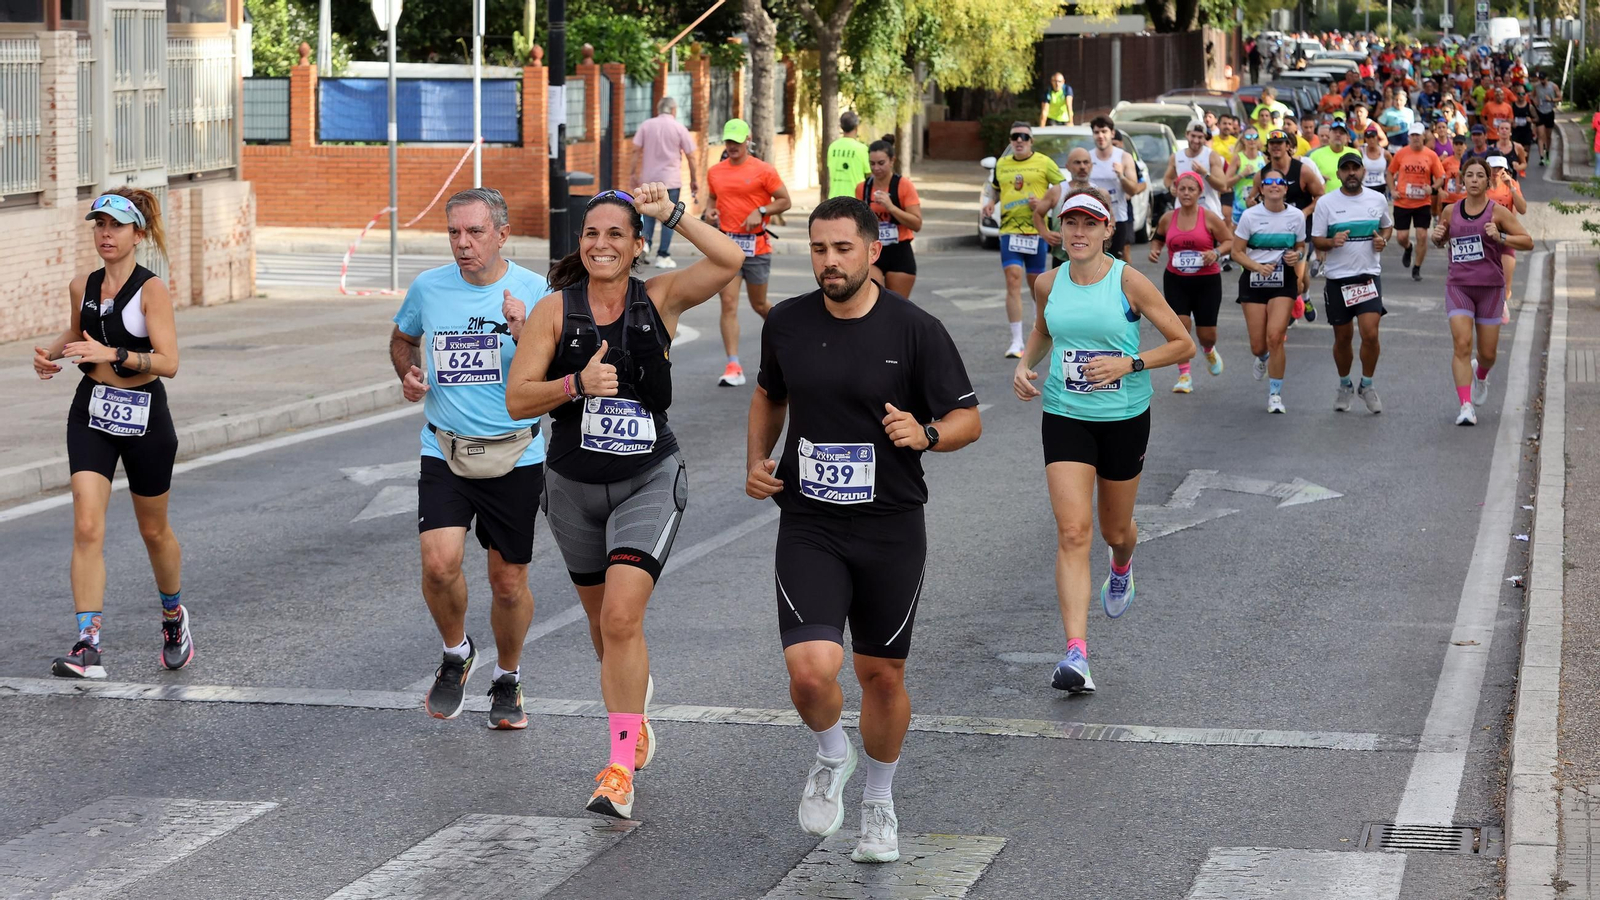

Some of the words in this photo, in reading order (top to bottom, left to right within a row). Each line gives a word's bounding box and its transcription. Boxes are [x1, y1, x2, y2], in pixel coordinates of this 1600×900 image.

[832, 149, 856, 158] STAFF
[1458, 244, 1475, 253] 919
[1180, 258, 1196, 266] 597
[1256, 273, 1279, 281] 1124
[1350, 286, 1368, 297] 262
[467, 316, 485, 330] 21K
[448, 351, 484, 369] 624
[102, 402, 133, 421] 963
[600, 416, 639, 437] 940
[814, 462, 854, 485] 939
